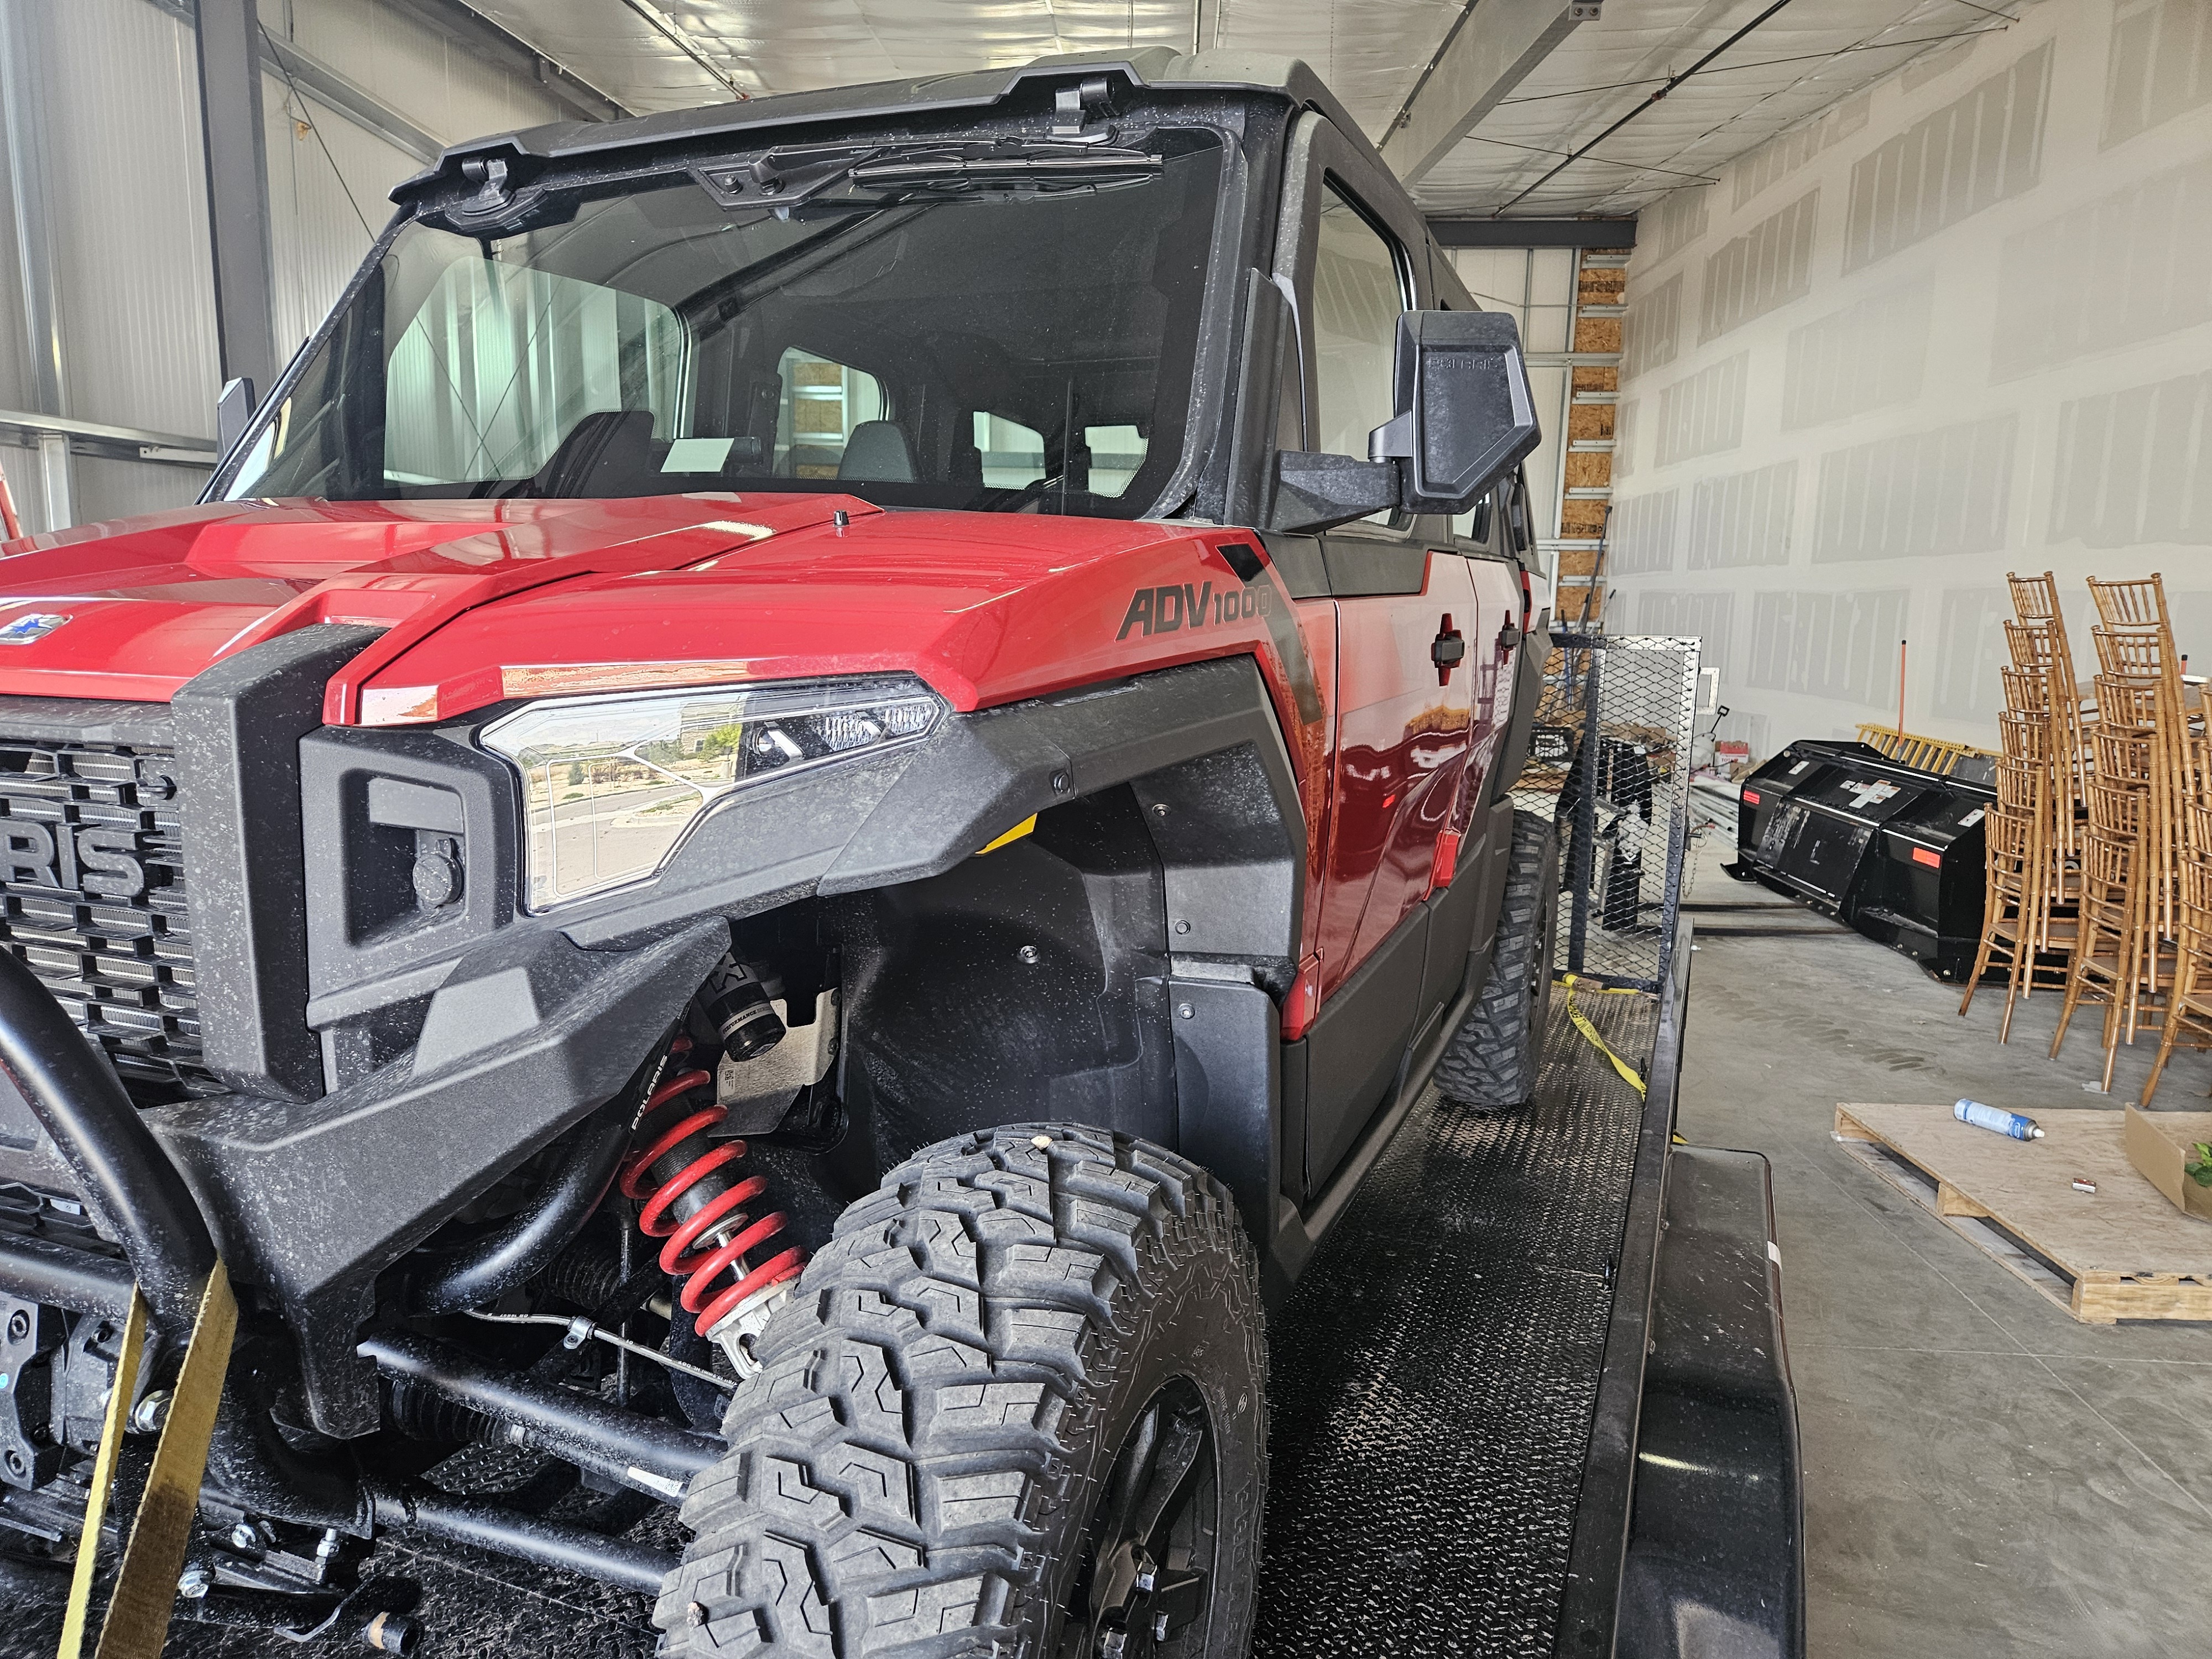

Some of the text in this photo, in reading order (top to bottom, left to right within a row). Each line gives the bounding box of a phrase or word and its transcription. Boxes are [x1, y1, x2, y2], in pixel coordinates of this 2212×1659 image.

[1114, 581, 1271, 643] ADV 1000
[631, 1055, 667, 1130] POLARIS
